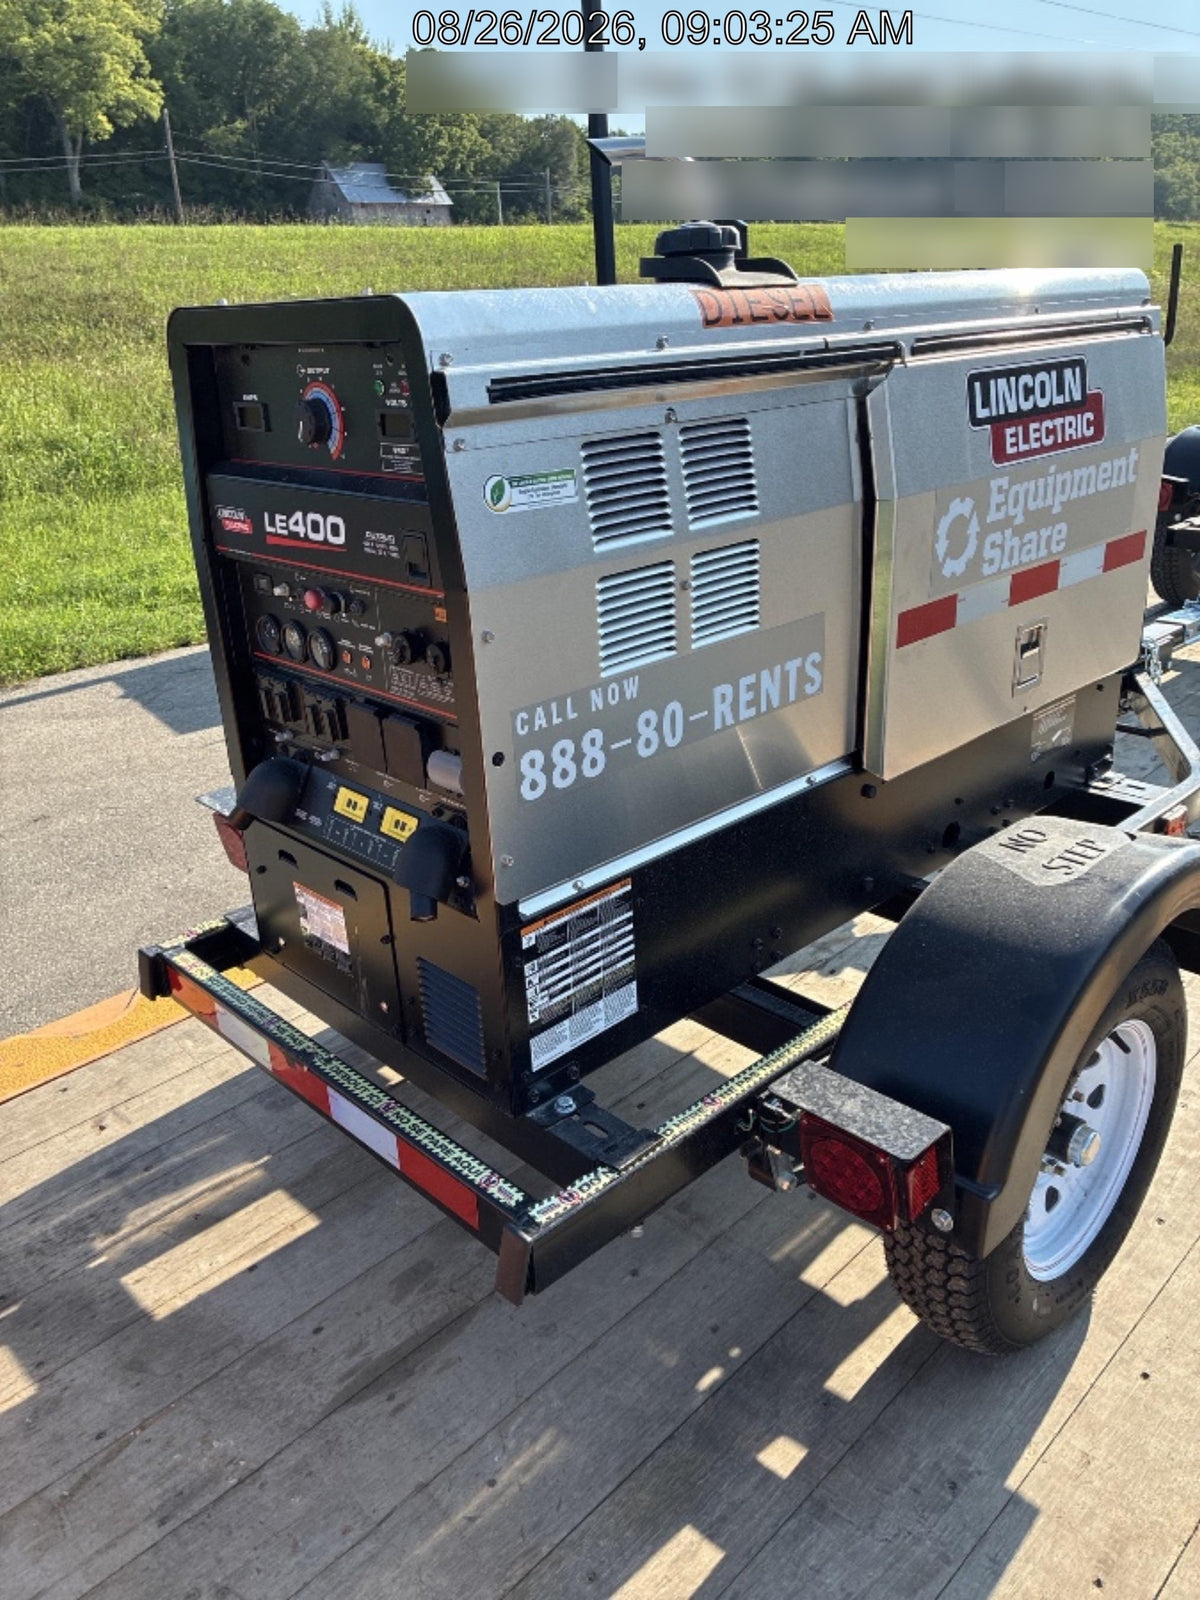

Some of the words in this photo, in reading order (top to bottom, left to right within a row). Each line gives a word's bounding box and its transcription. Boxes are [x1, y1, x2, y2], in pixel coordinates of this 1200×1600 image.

[695, 285, 833, 326] DIESEL
[973, 365, 1083, 419] LINCOLN
[1004, 411, 1095, 455] ELECTRIC
[986, 447, 1139, 526] Equipment
[264, 510, 346, 545] LE400
[981, 521, 1068, 577] Share
[515, 696, 579, 736] CALL
[590, 675, 640, 712] NOW
[519, 651, 823, 801] 888-80-RENTS
[998, 829, 1048, 854] NO
[1041, 838, 1106, 876] STEP
[392, 1109, 411, 1126] NO
[407, 1121, 427, 1137] SE
[422, 1132, 457, 1159] PARE
